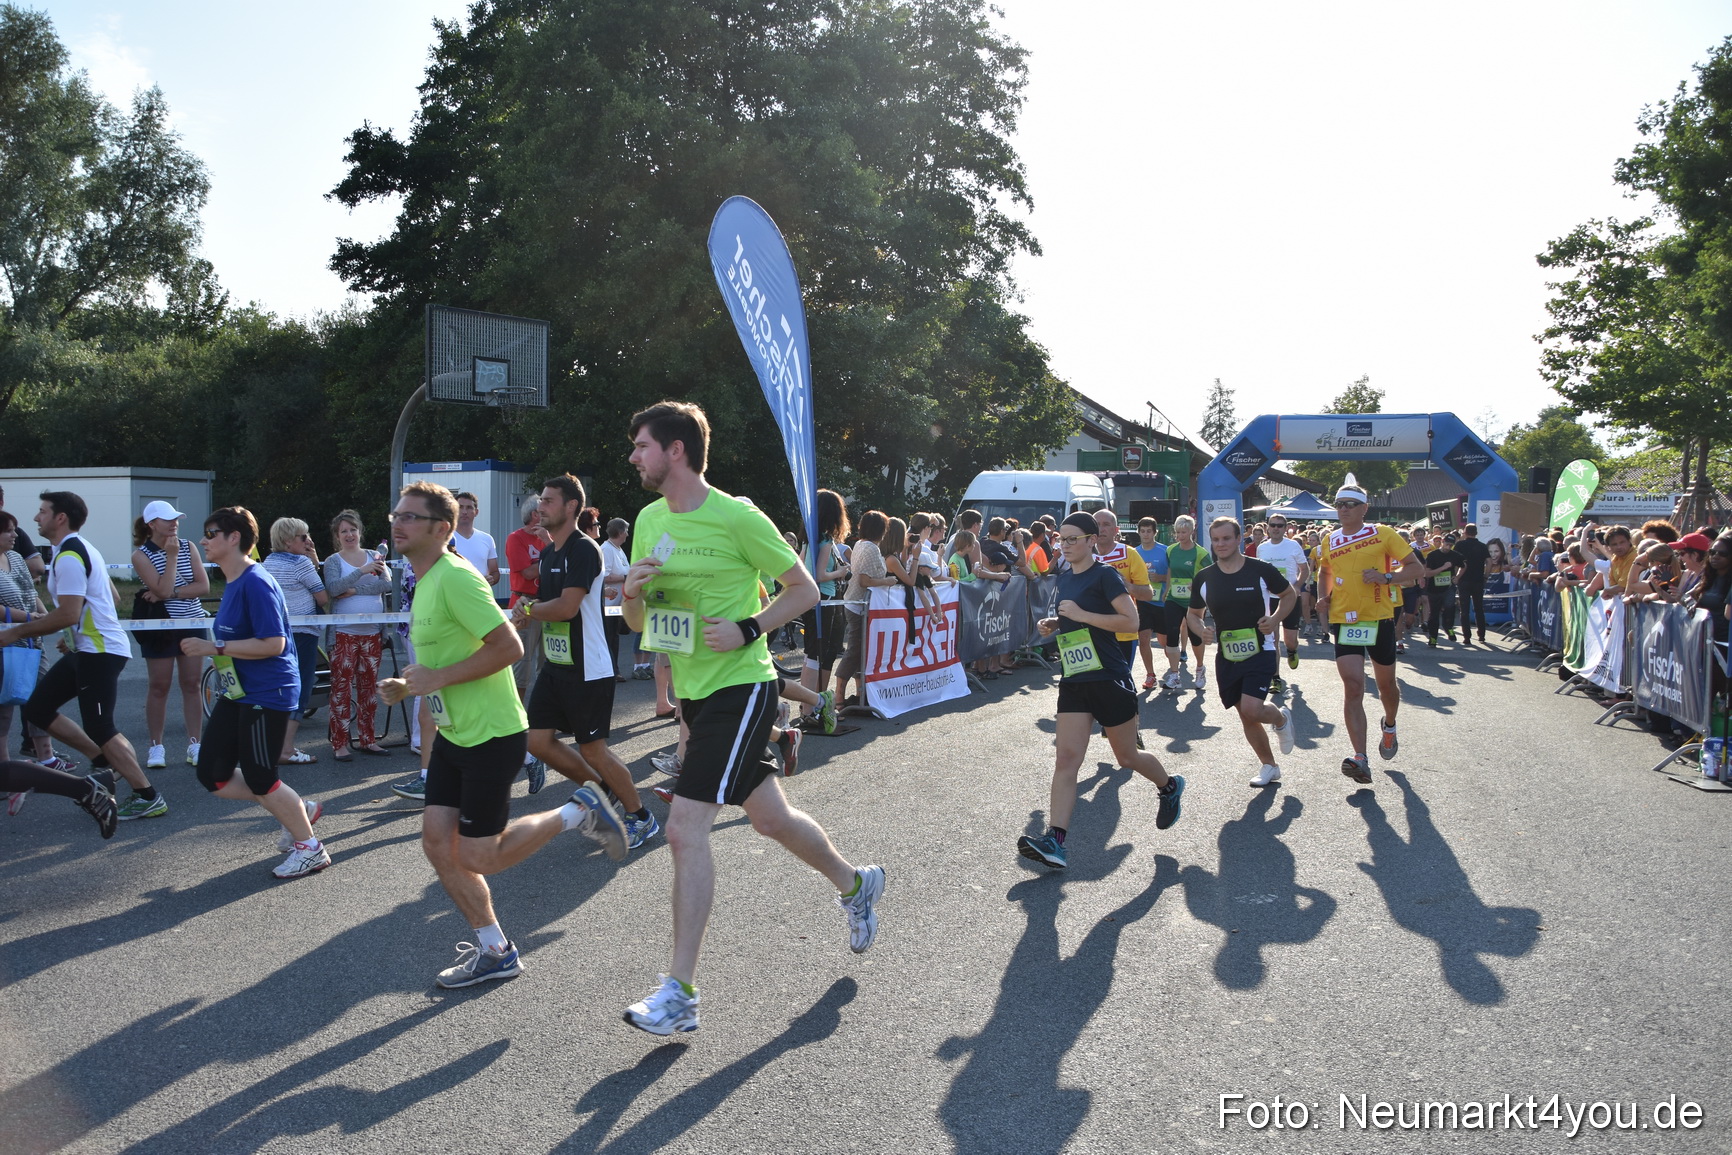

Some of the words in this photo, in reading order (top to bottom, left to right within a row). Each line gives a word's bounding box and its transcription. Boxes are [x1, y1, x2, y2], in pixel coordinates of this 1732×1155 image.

[1337, 436, 1394, 447] firmenlauf
[1601, 494, 1624, 502] Jura
[1634, 494, 1669, 502] Hallen
[1431, 508, 1446, 521] RW
[1462, 502, 1468, 513] R
[1554, 498, 1575, 520] AOK
[1330, 547, 1352, 560] MAX
[1355, 537, 1382, 550] BÖGL
[651, 613, 689, 638] 1101
[1346, 628, 1369, 639] 891
[546, 637, 568, 653] 1093
[865, 609, 957, 674] MEIER
[1226, 641, 1255, 653] 1086
[1063, 646, 1093, 665] 1300
[1648, 647, 1684, 685] Fischer
[221, 671, 236, 688] 96
[426, 695, 443, 713] 00
